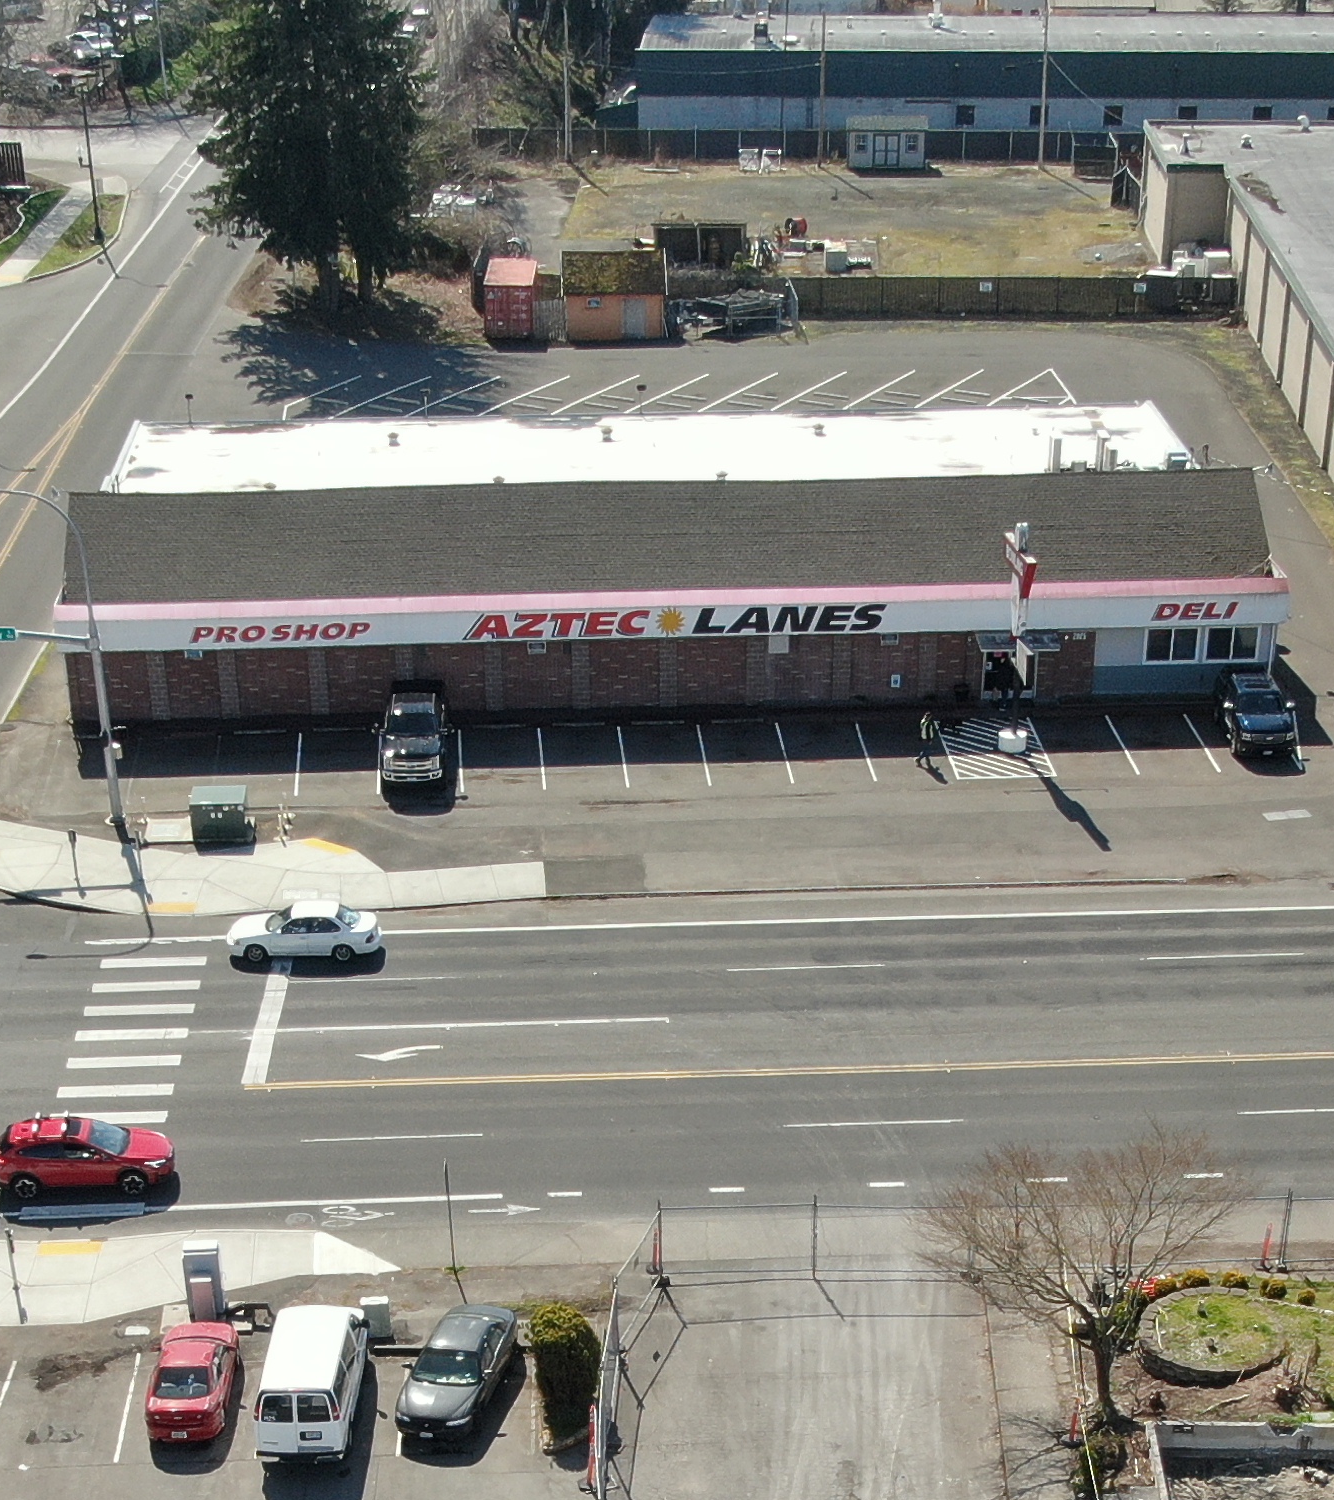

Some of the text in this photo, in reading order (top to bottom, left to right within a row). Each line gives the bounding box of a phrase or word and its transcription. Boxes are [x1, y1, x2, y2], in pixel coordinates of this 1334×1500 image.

[463, 603, 888, 640] AZTEC LANES
[1151, 601, 1239, 622] DELI
